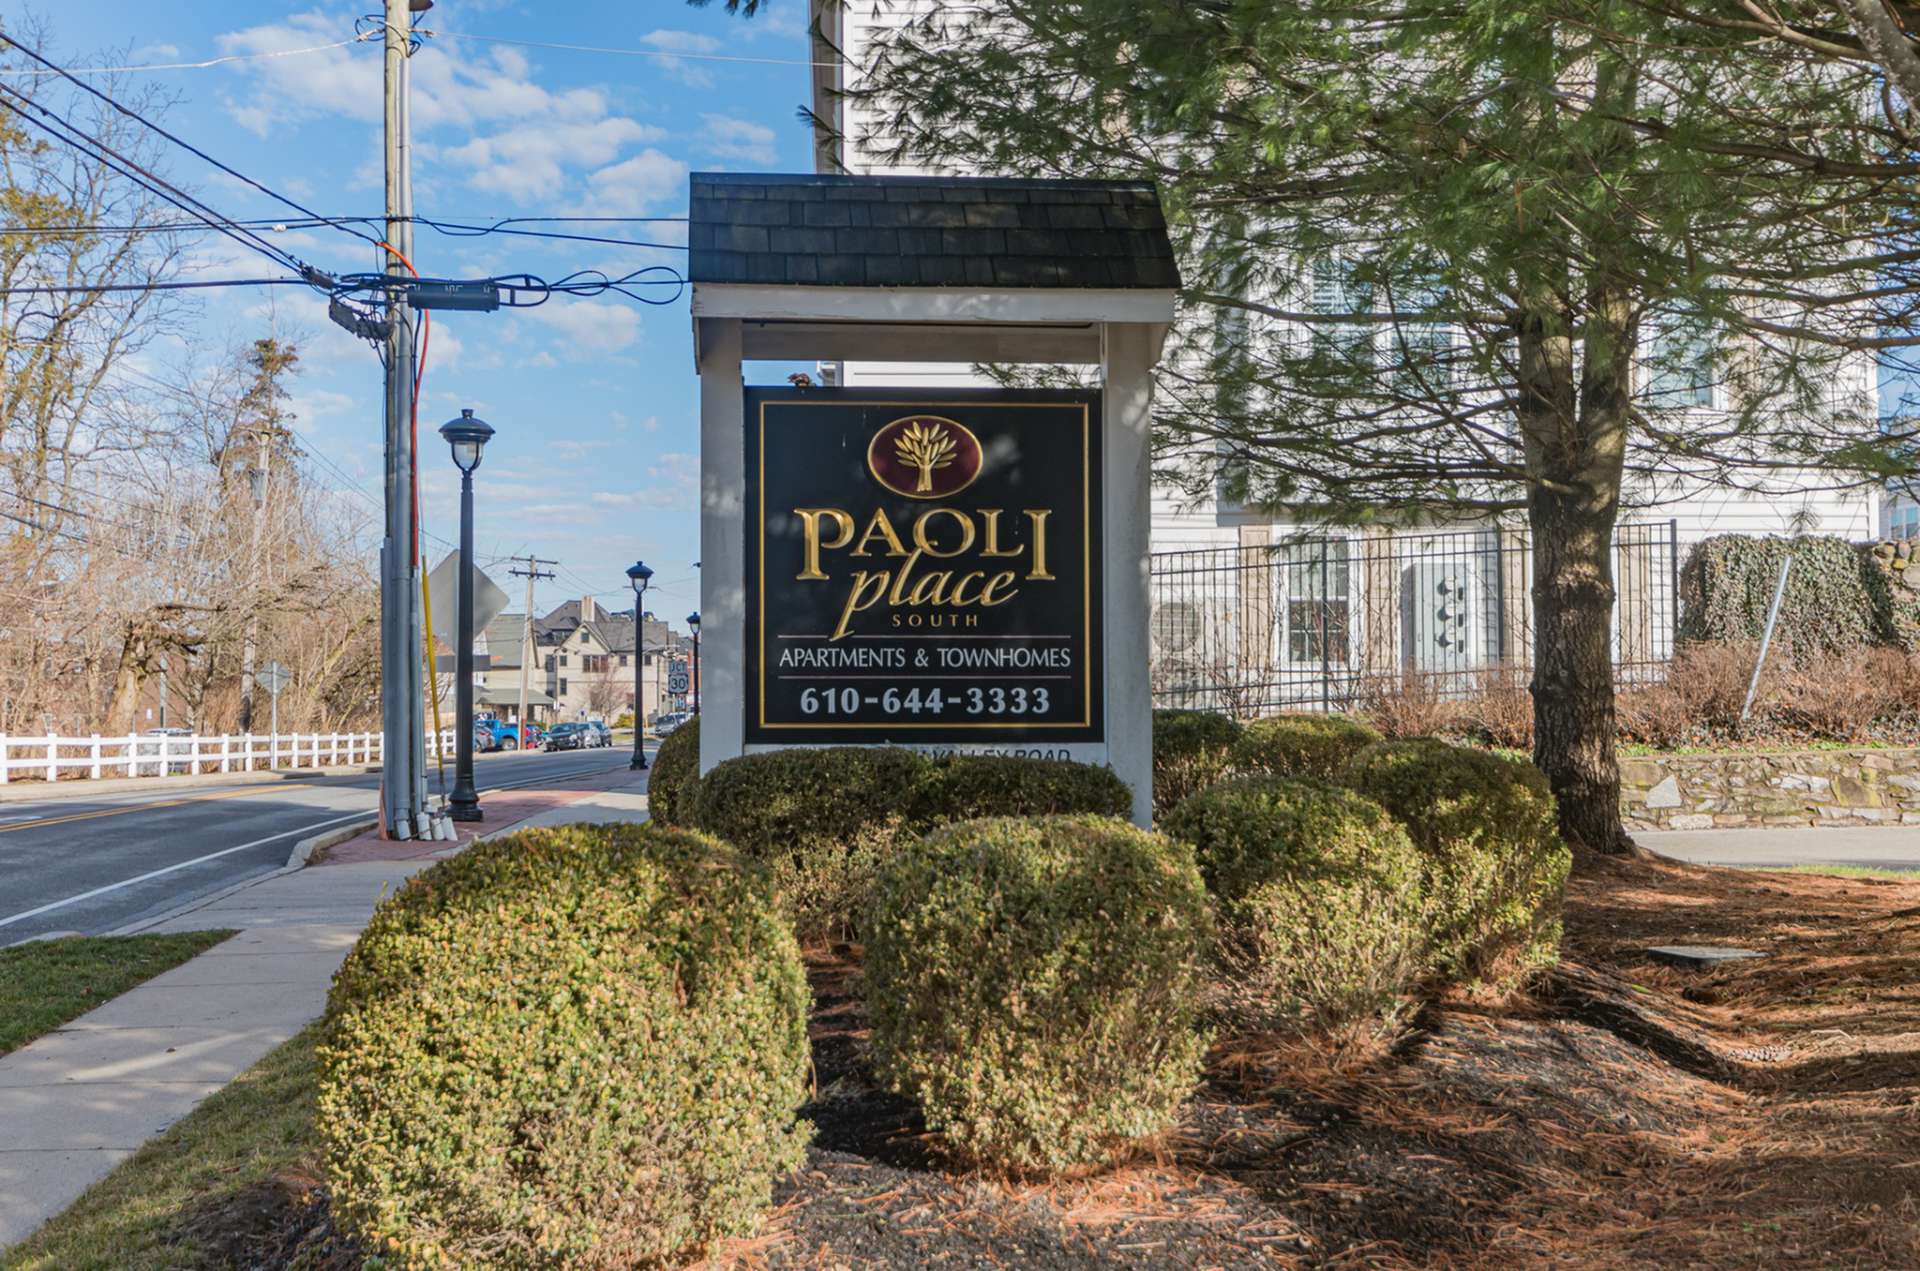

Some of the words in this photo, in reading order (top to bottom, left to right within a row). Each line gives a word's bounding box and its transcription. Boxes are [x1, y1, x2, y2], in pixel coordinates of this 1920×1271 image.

[793, 507, 1056, 580] PAOLI
[829, 547, 1019, 642] place
[892, 614, 978, 627] SOUTH
[779, 648, 906, 668] APARTMENTS
[914, 647, 929, 667] &
[937, 648, 1071, 667] TOWNHOMES
[671, 678, 686, 689] 30
[800, 687, 1050, 714] 610-644-3333
